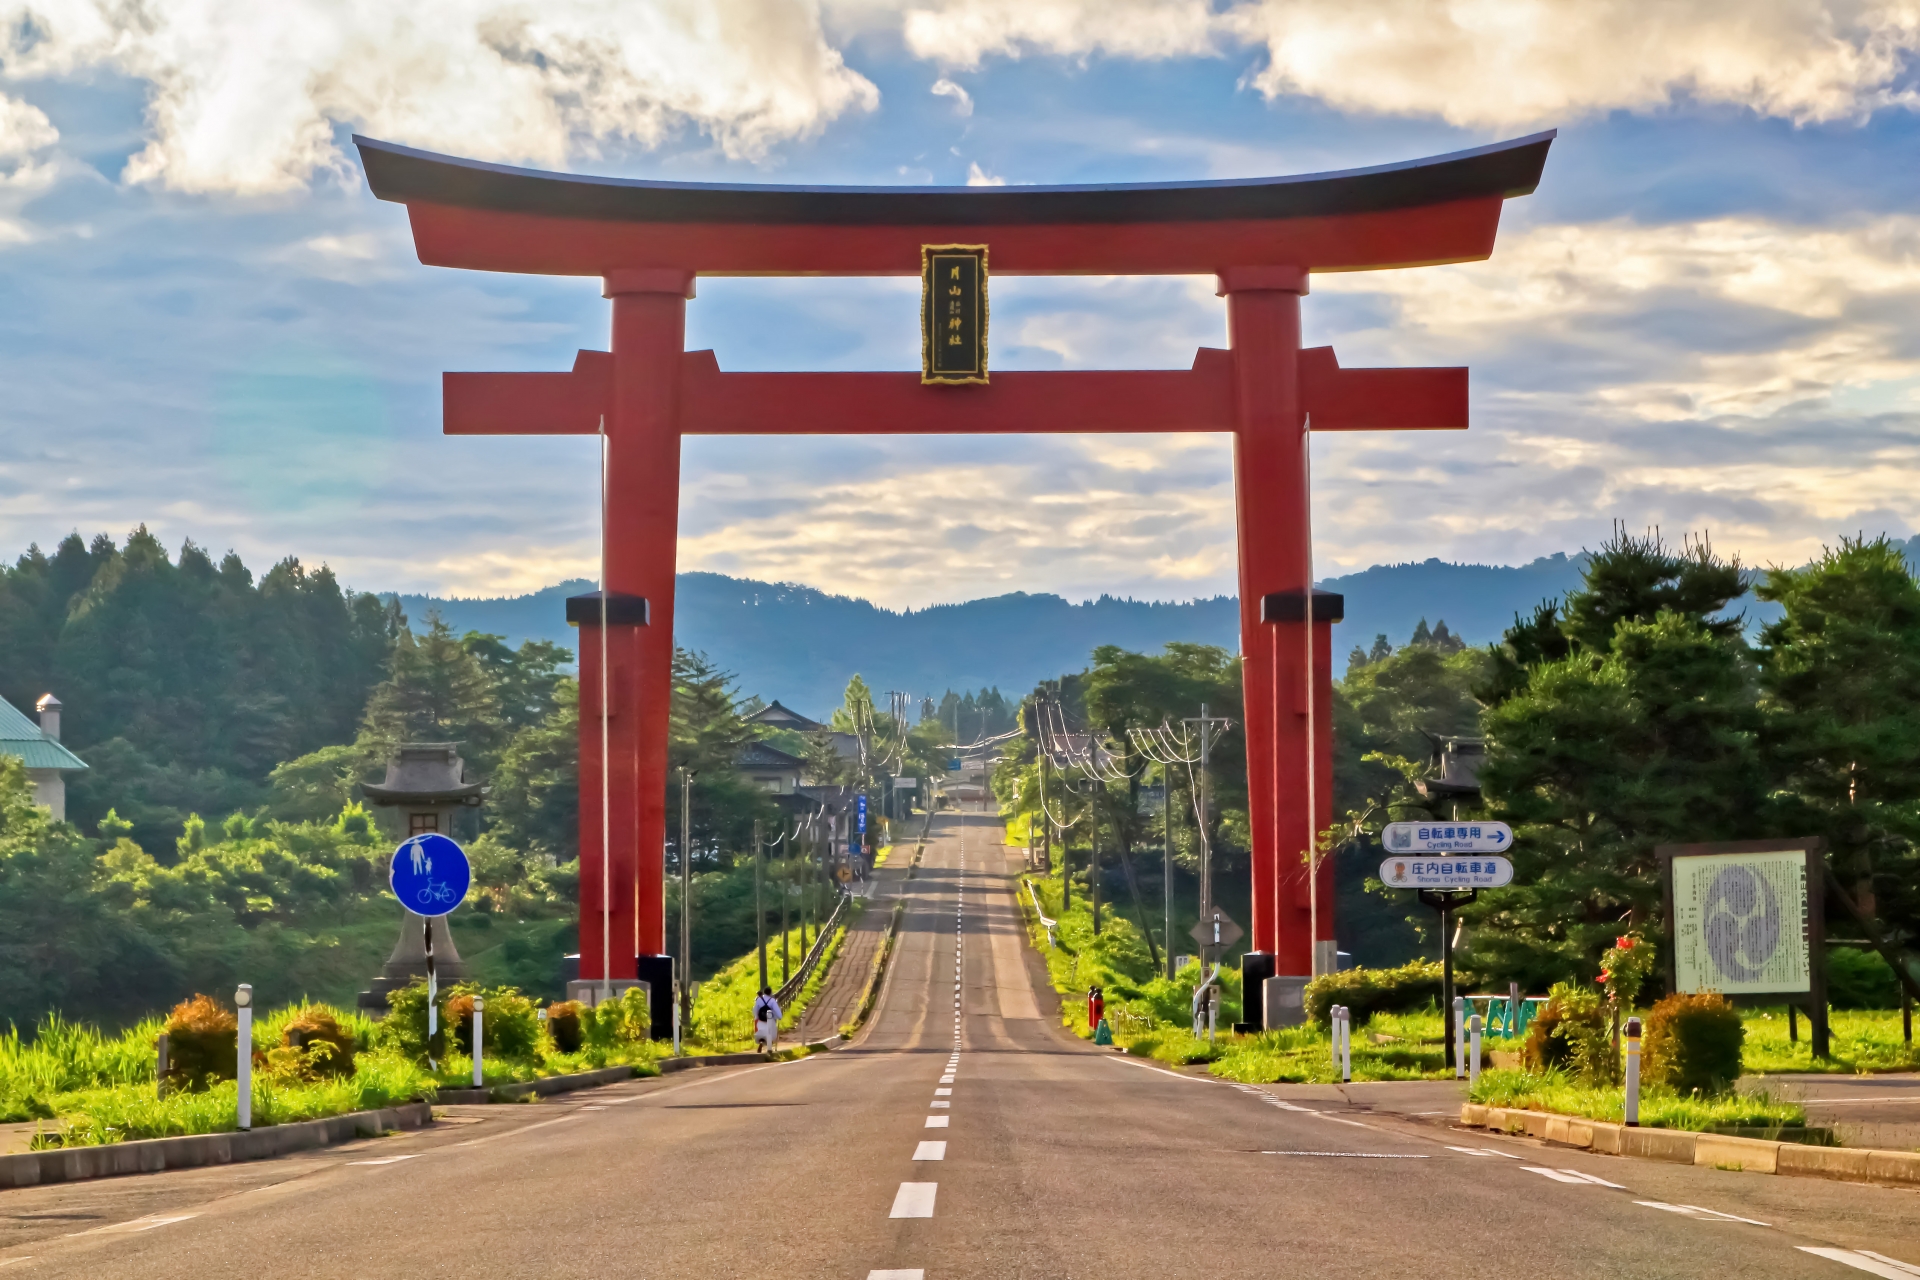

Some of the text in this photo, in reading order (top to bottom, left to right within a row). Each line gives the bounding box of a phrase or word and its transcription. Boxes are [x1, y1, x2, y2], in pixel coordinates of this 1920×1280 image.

[1419, 827, 1481, 839] 自転車専用
[1413, 862, 1496, 874] 庄内自転車道
